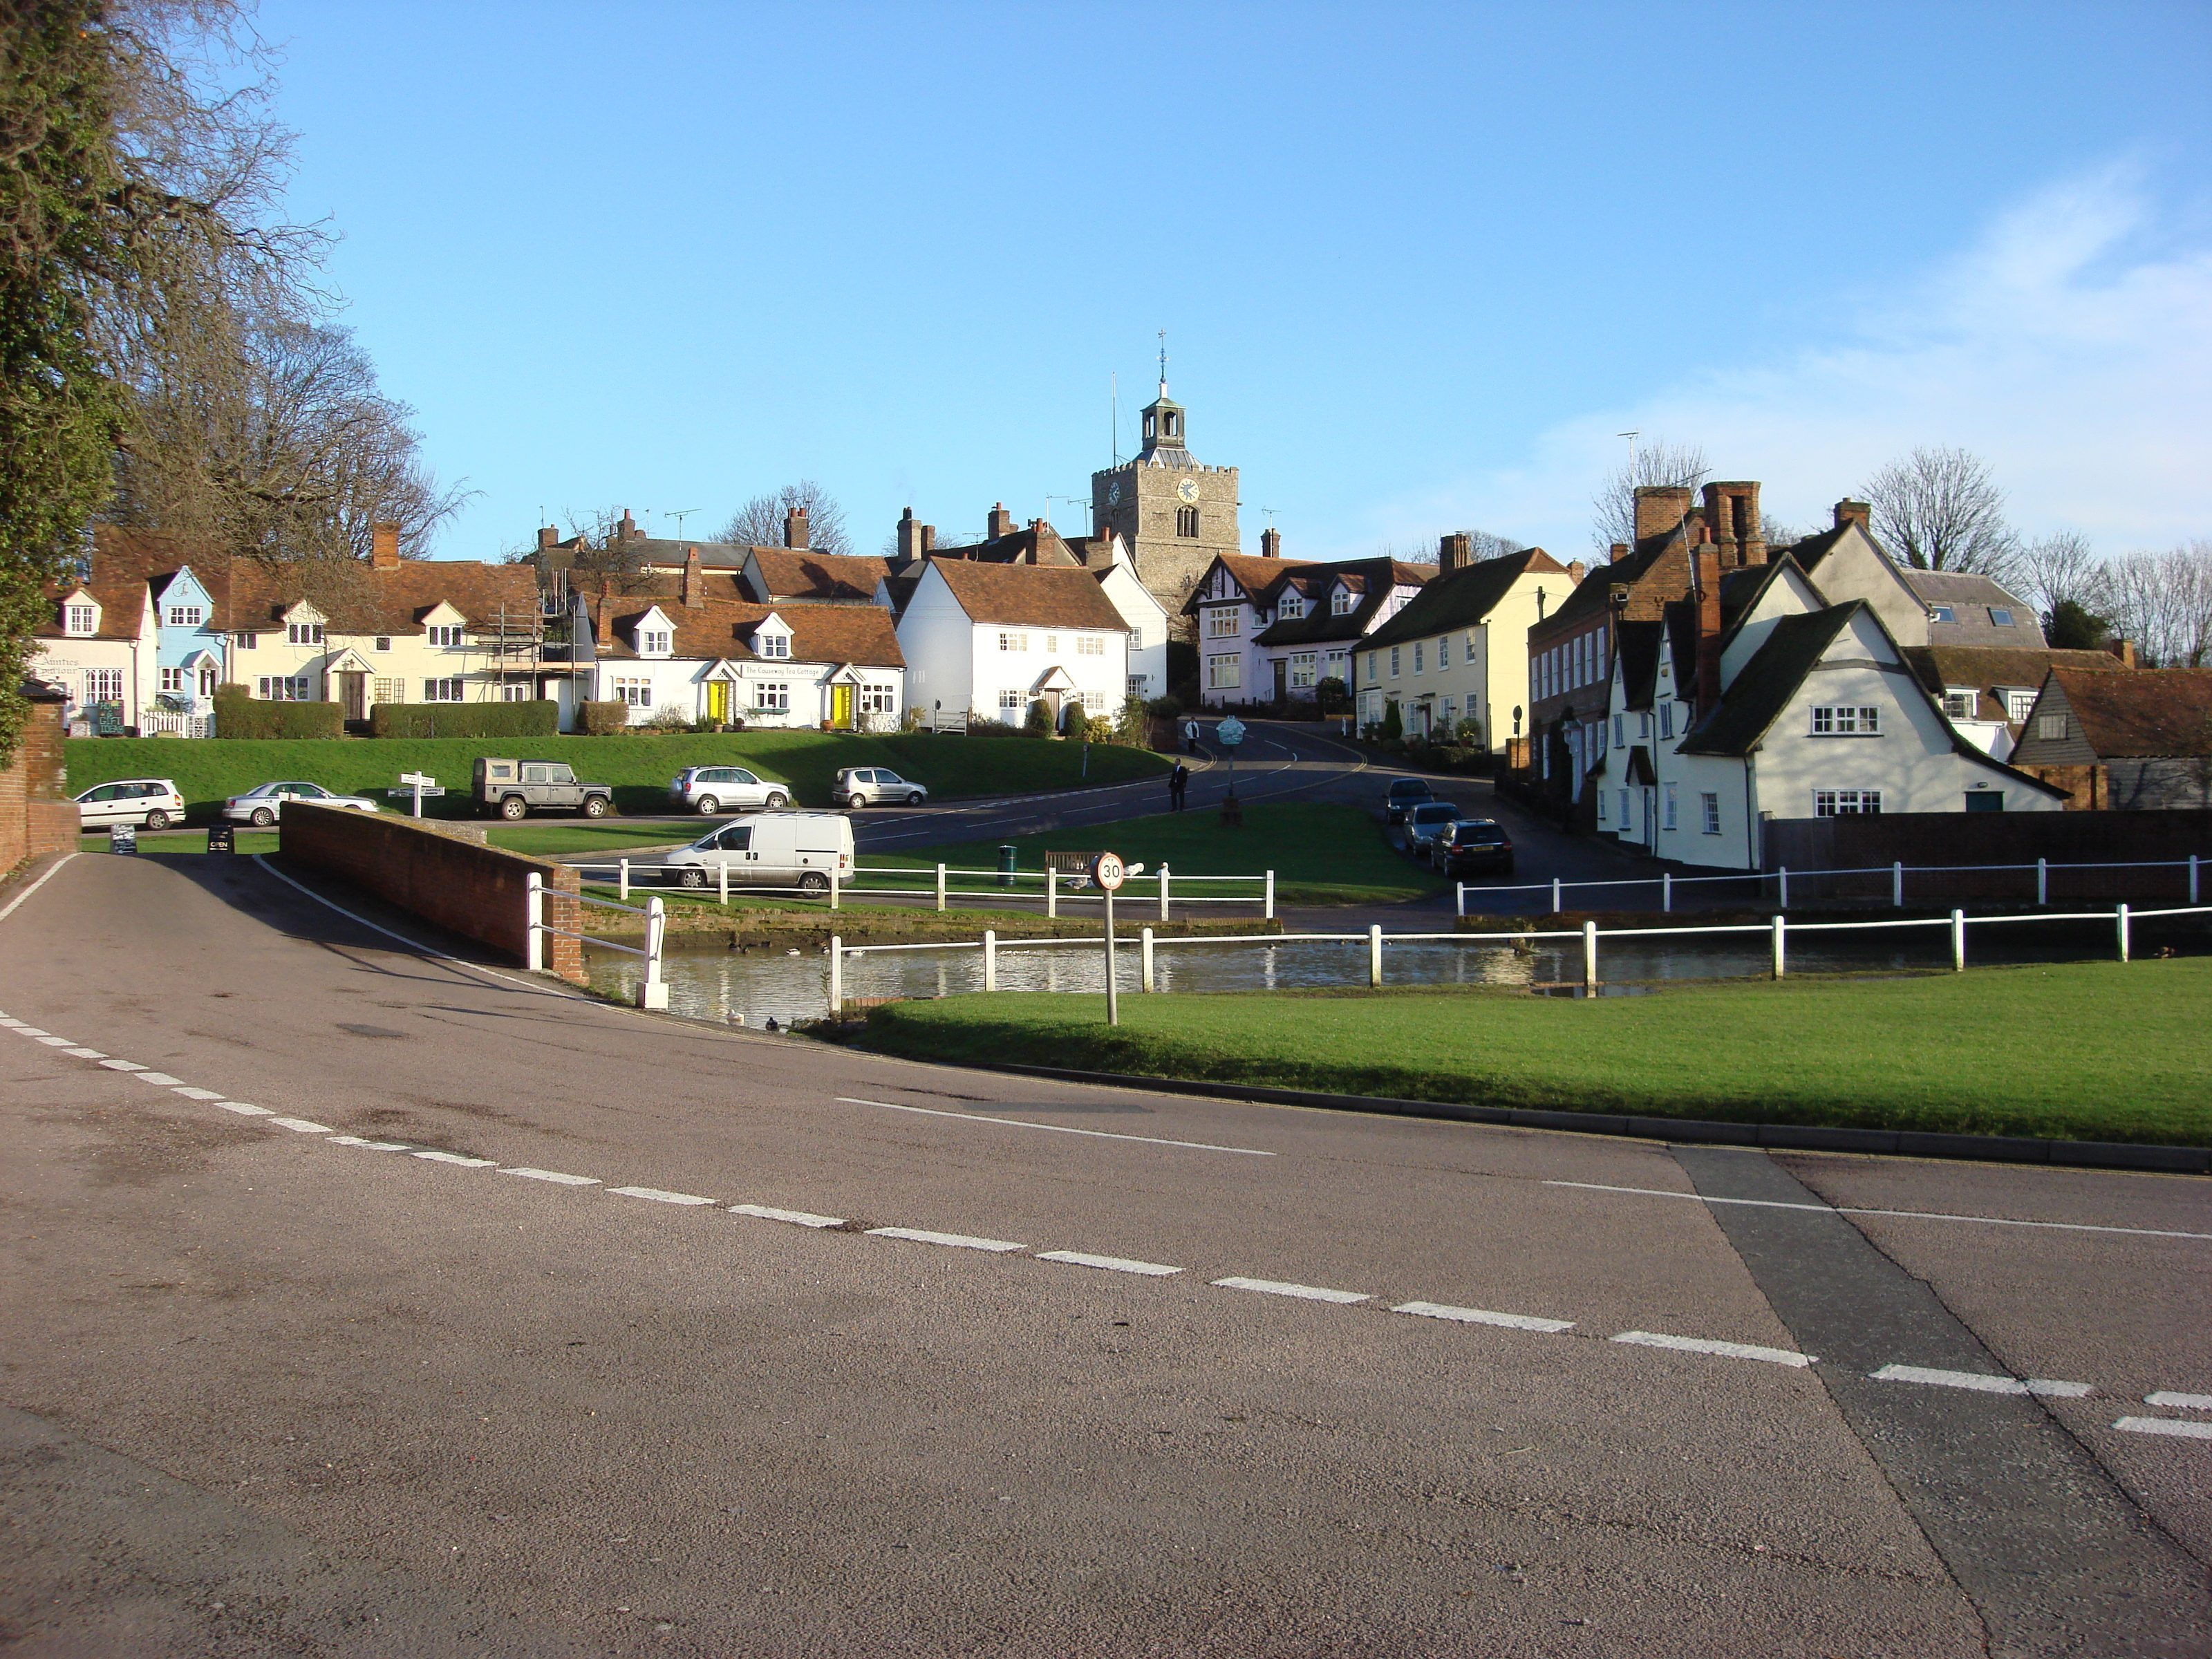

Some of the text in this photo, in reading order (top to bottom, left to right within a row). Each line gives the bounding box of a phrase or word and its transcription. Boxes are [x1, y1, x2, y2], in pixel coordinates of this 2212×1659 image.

[44, 656, 79, 666] Aunties
[758, 667, 785, 676] Causeway
[797, 668, 819, 677] Cottage
[1104, 865, 1120, 878] 30
